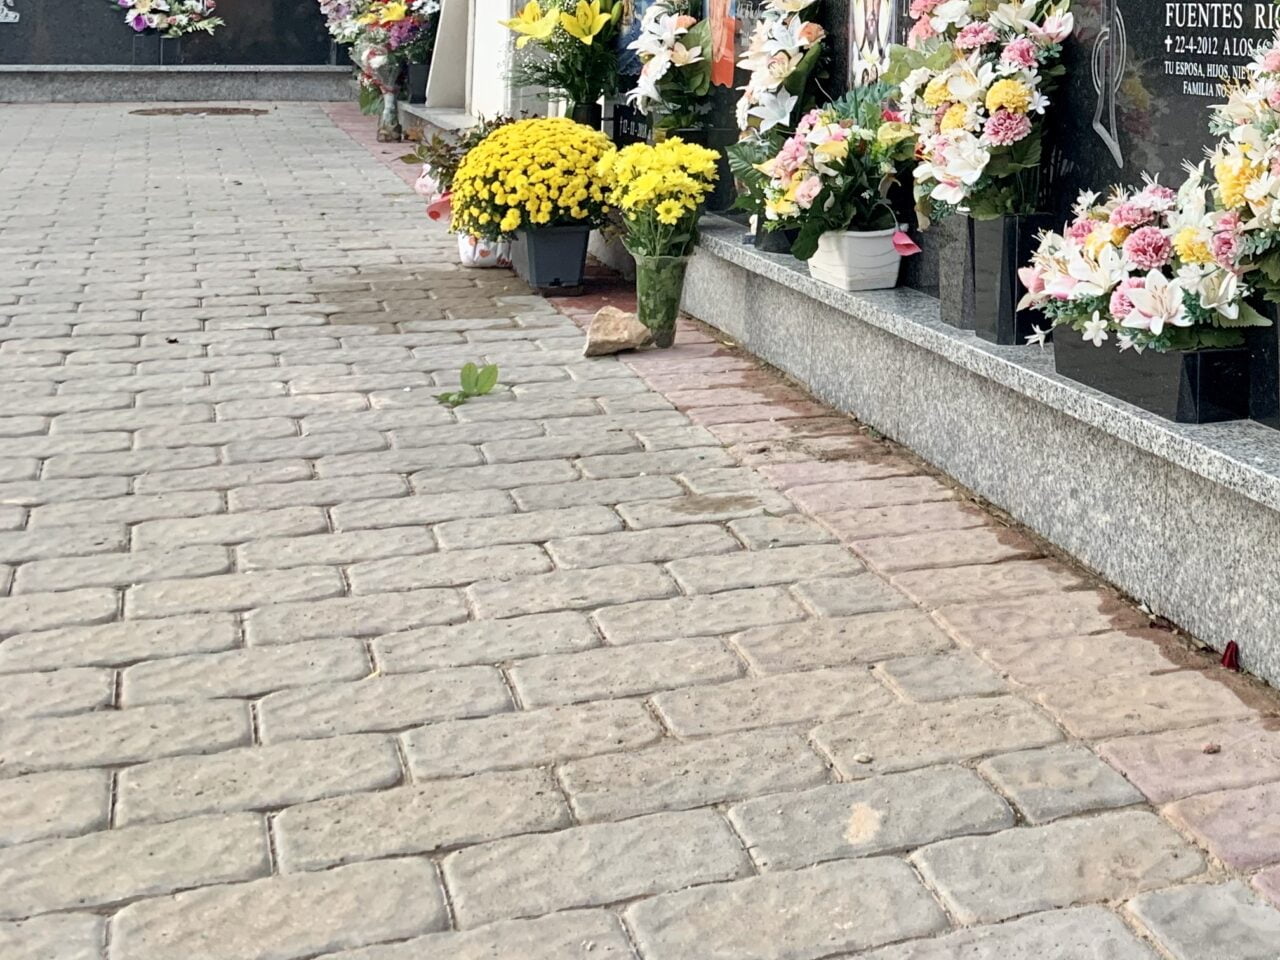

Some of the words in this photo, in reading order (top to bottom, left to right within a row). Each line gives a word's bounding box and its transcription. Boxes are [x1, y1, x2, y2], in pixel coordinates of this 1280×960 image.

[1165, 2, 1243, 28] FUENTES
[1175, 35, 1218, 55] 22-4-2012
[1223, 37, 1231, 56] A
[1233, 37, 1252, 57] LOS
[1164, 60, 1175, 75] TU
[1175, 62, 1205, 79] ESPOSA,
[1206, 64, 1231, 79] HIJOS,
[1182, 80, 1214, 95] FAMILIA
